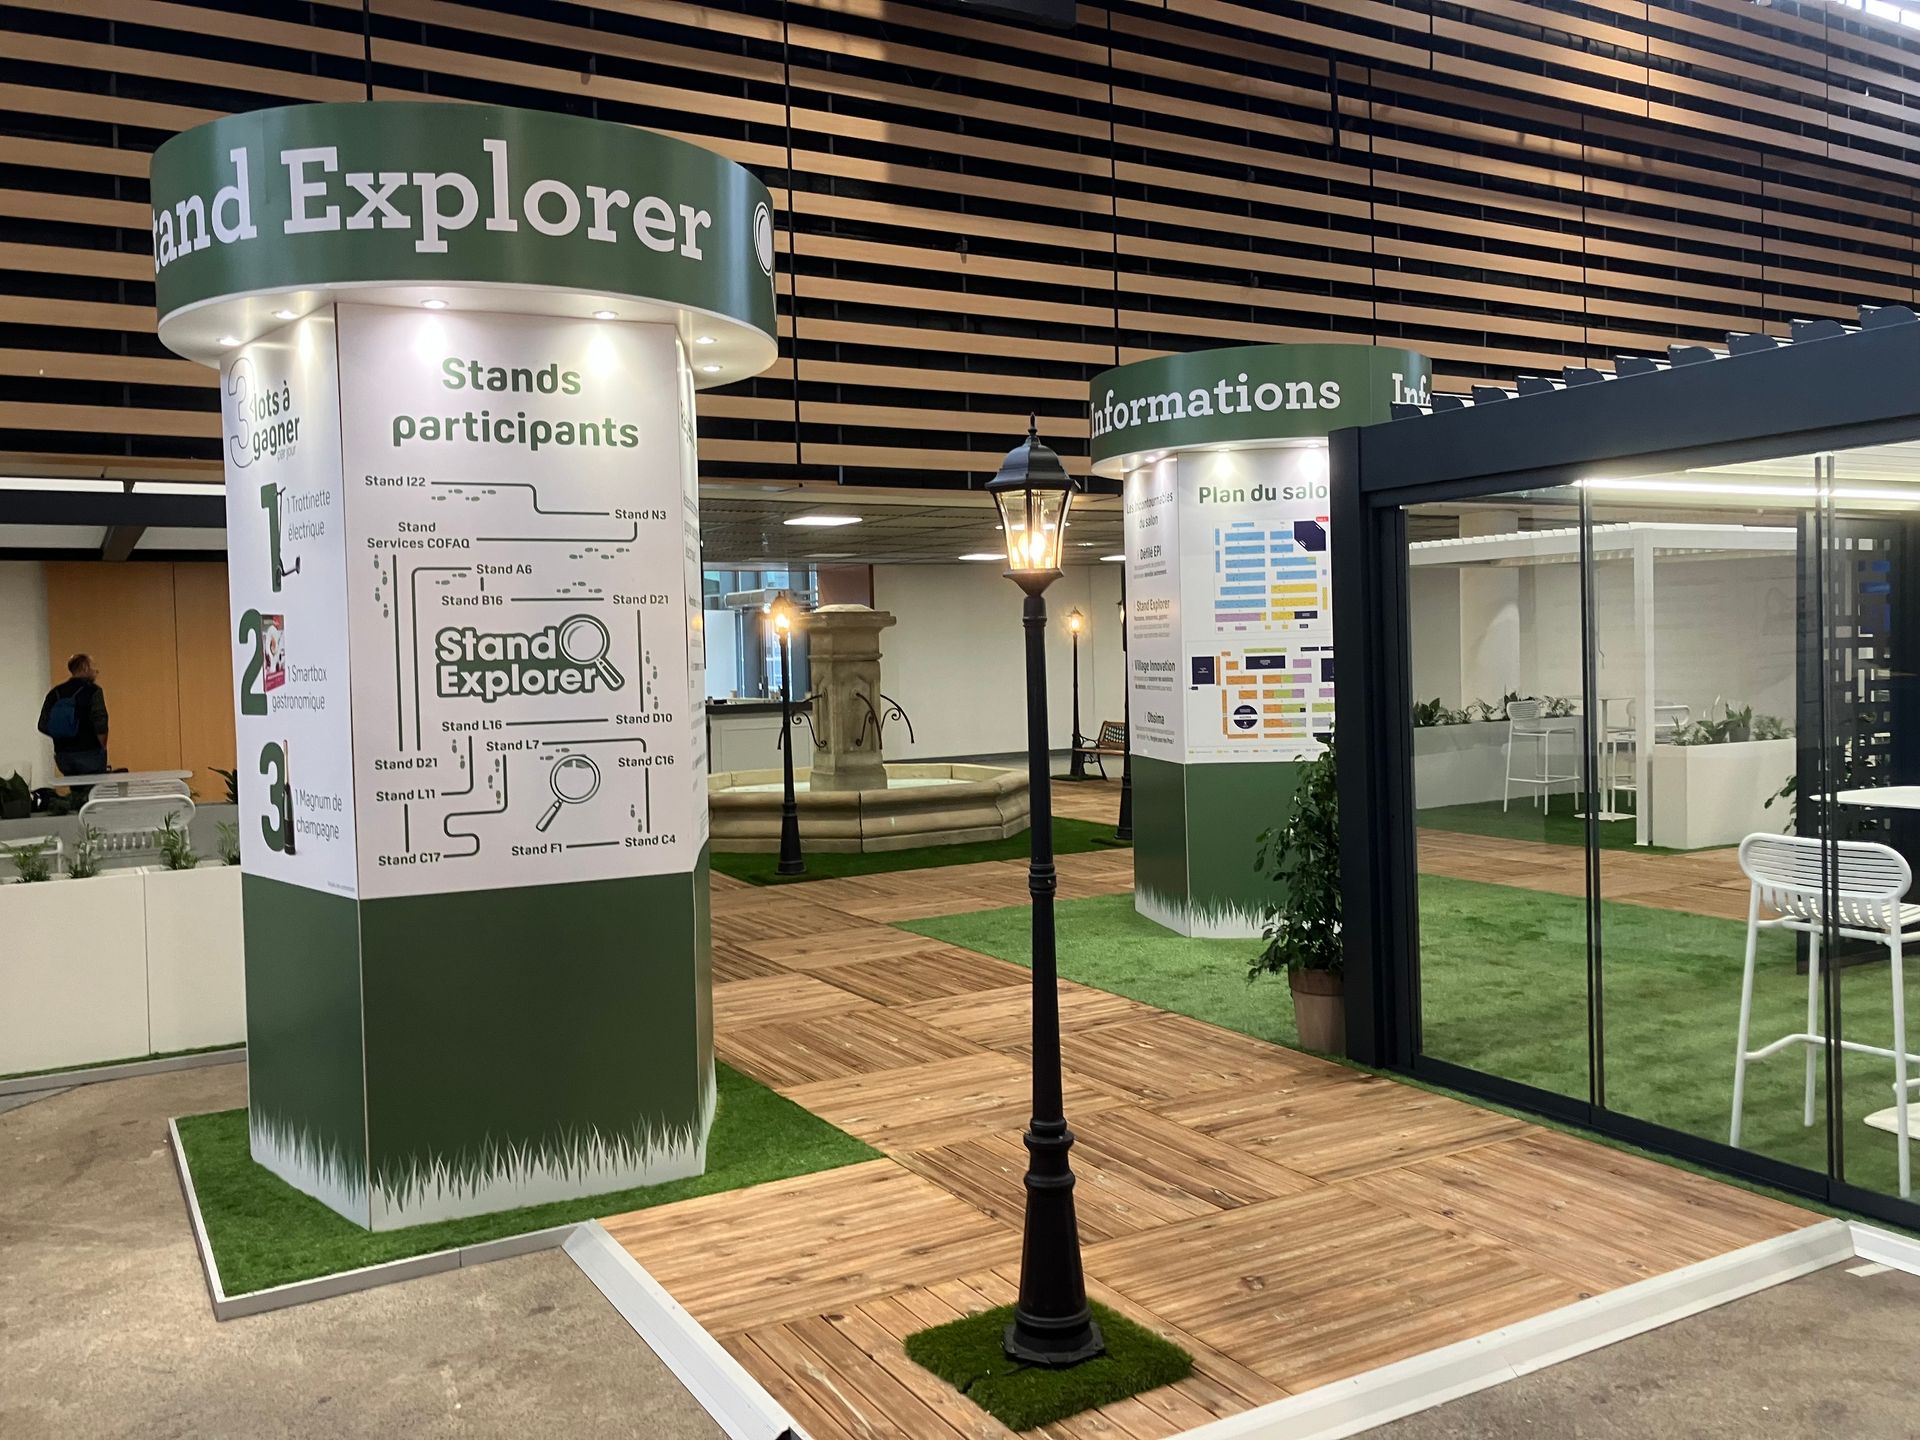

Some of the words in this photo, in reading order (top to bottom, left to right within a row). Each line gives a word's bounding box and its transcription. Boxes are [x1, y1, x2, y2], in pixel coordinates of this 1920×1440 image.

[280, 138, 712, 261] Explorer
[442, 357, 582, 395] Stands
[254, 389, 280, 421] lots
[282, 380, 290, 411] à
[1090, 372, 1341, 440] Informations
[392, 410, 640, 452] participants
[253, 417, 300, 461] gagner
[364, 475, 403, 487] Stand
[1199, 486, 1245, 503] Plan
[1250, 484, 1277, 502] du
[291, 490, 331, 513] Trottinette
[614, 508, 649, 520] Stand
[651, 509, 667, 520] N3
[288, 520, 325, 541] électrique
[398, 521, 437, 533] Stand
[366, 537, 424, 549] Services
[427, 538, 471, 549] COFAQ
[1153, 544, 1162, 557] EPI
[476, 563, 513, 575] Stand
[516, 564, 533, 575] A6
[441, 594, 479, 606] Stand
[481, 595, 503, 606] B16
[612, 593, 647, 605] Stand
[649, 594, 669, 605] D21
[1136, 600, 1149, 611] Stand
[1150, 598, 1170, 613] Explorer
[439, 629, 557, 662] Stand
[239, 608, 267, 716] 2
[1134, 660, 1149, 674] Village
[1149, 660, 1175, 672] Innovation
[291, 664, 327, 683] Smartbox
[440, 664, 599, 700] Explorer
[272, 692, 326, 713] gastronomique
[441, 720, 480, 732] Stand
[482, 719, 503, 731] L16
[615, 713, 650, 725] Stand
[652, 712, 673, 723] D10
[486, 740, 523, 752] Stand
[525, 740, 540, 750] L7
[374, 758, 413, 771] Stand
[416, 757, 438, 769] D21
[617, 756, 652, 768] Stand
[654, 755, 675, 766] C16
[259, 741, 286, 852] 3
[299, 789, 332, 811] Magnum
[332, 794, 342, 812] de
[375, 789, 415, 802] Stand
[417, 788, 436, 800] L11
[296, 816, 340, 841] champagne
[624, 835, 659, 848] Stand
[661, 834, 676, 846] C4
[511, 844, 548, 857] Stand
[550, 842, 563, 854] F1
[378, 853, 417, 867] Stand
[419, 852, 441, 864] C17
